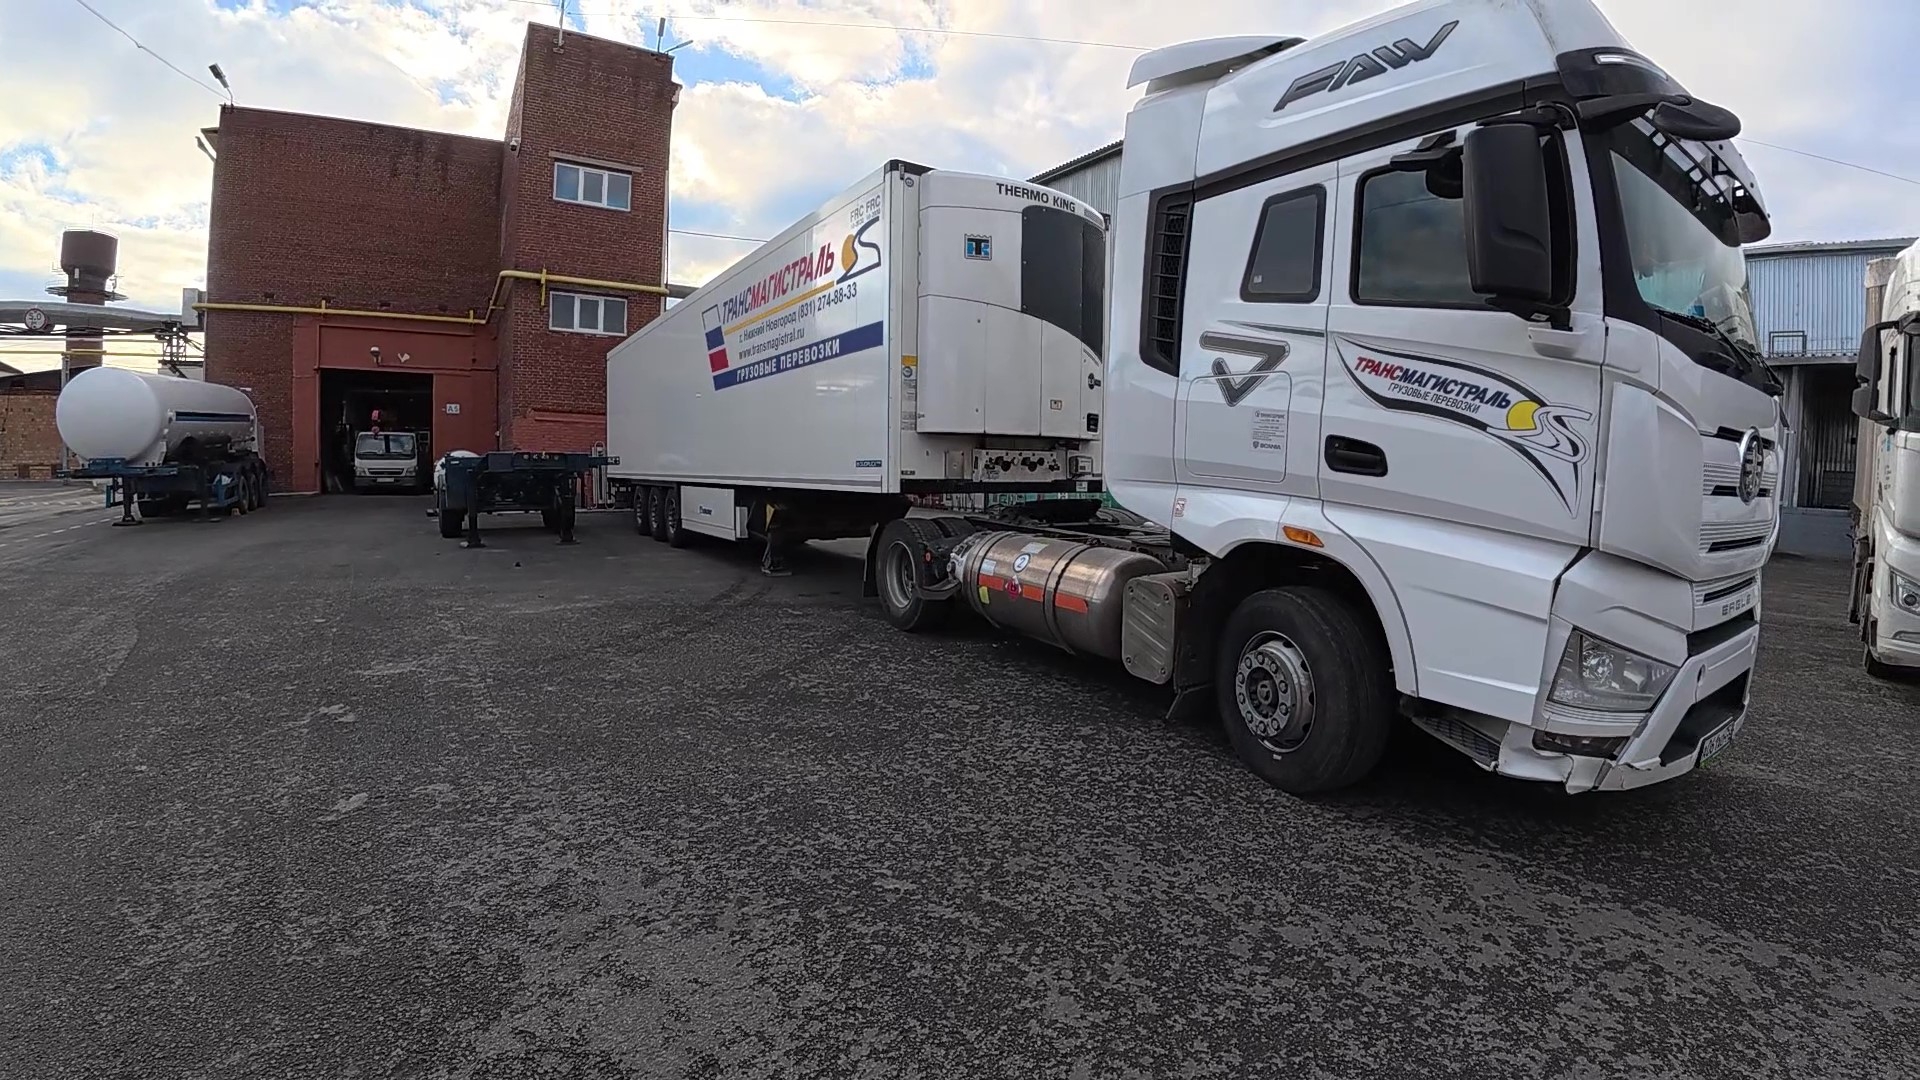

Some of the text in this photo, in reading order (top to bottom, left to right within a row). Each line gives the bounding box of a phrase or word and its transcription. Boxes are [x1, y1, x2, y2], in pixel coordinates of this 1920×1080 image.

[1273, 20, 1459, 112] FAW
[996, 182, 1076, 213] THERMO KING
[722, 241, 835, 325] ТРАНСМАГИСТРАЛЬ
[744, 321, 765, 341] Нижний
[766, 311, 797, 333] Новгород
[798, 299, 816, 323] (831)
[817, 281, 858, 312] 274-88-33
[736, 338, 840, 383] ГРУЗОВЫЕ ПЕРЕВОЗКИ
[739, 327, 805, 360] www.transmagistral.ru
[1354, 356, 1513, 409] ТРАНСМАГИСТРАЛЬ
[1387, 382, 1480, 414] ГРУЗОВЫЕ ПЕРЕВОЗКИ
[1016, 556, 1026, 568] 2
